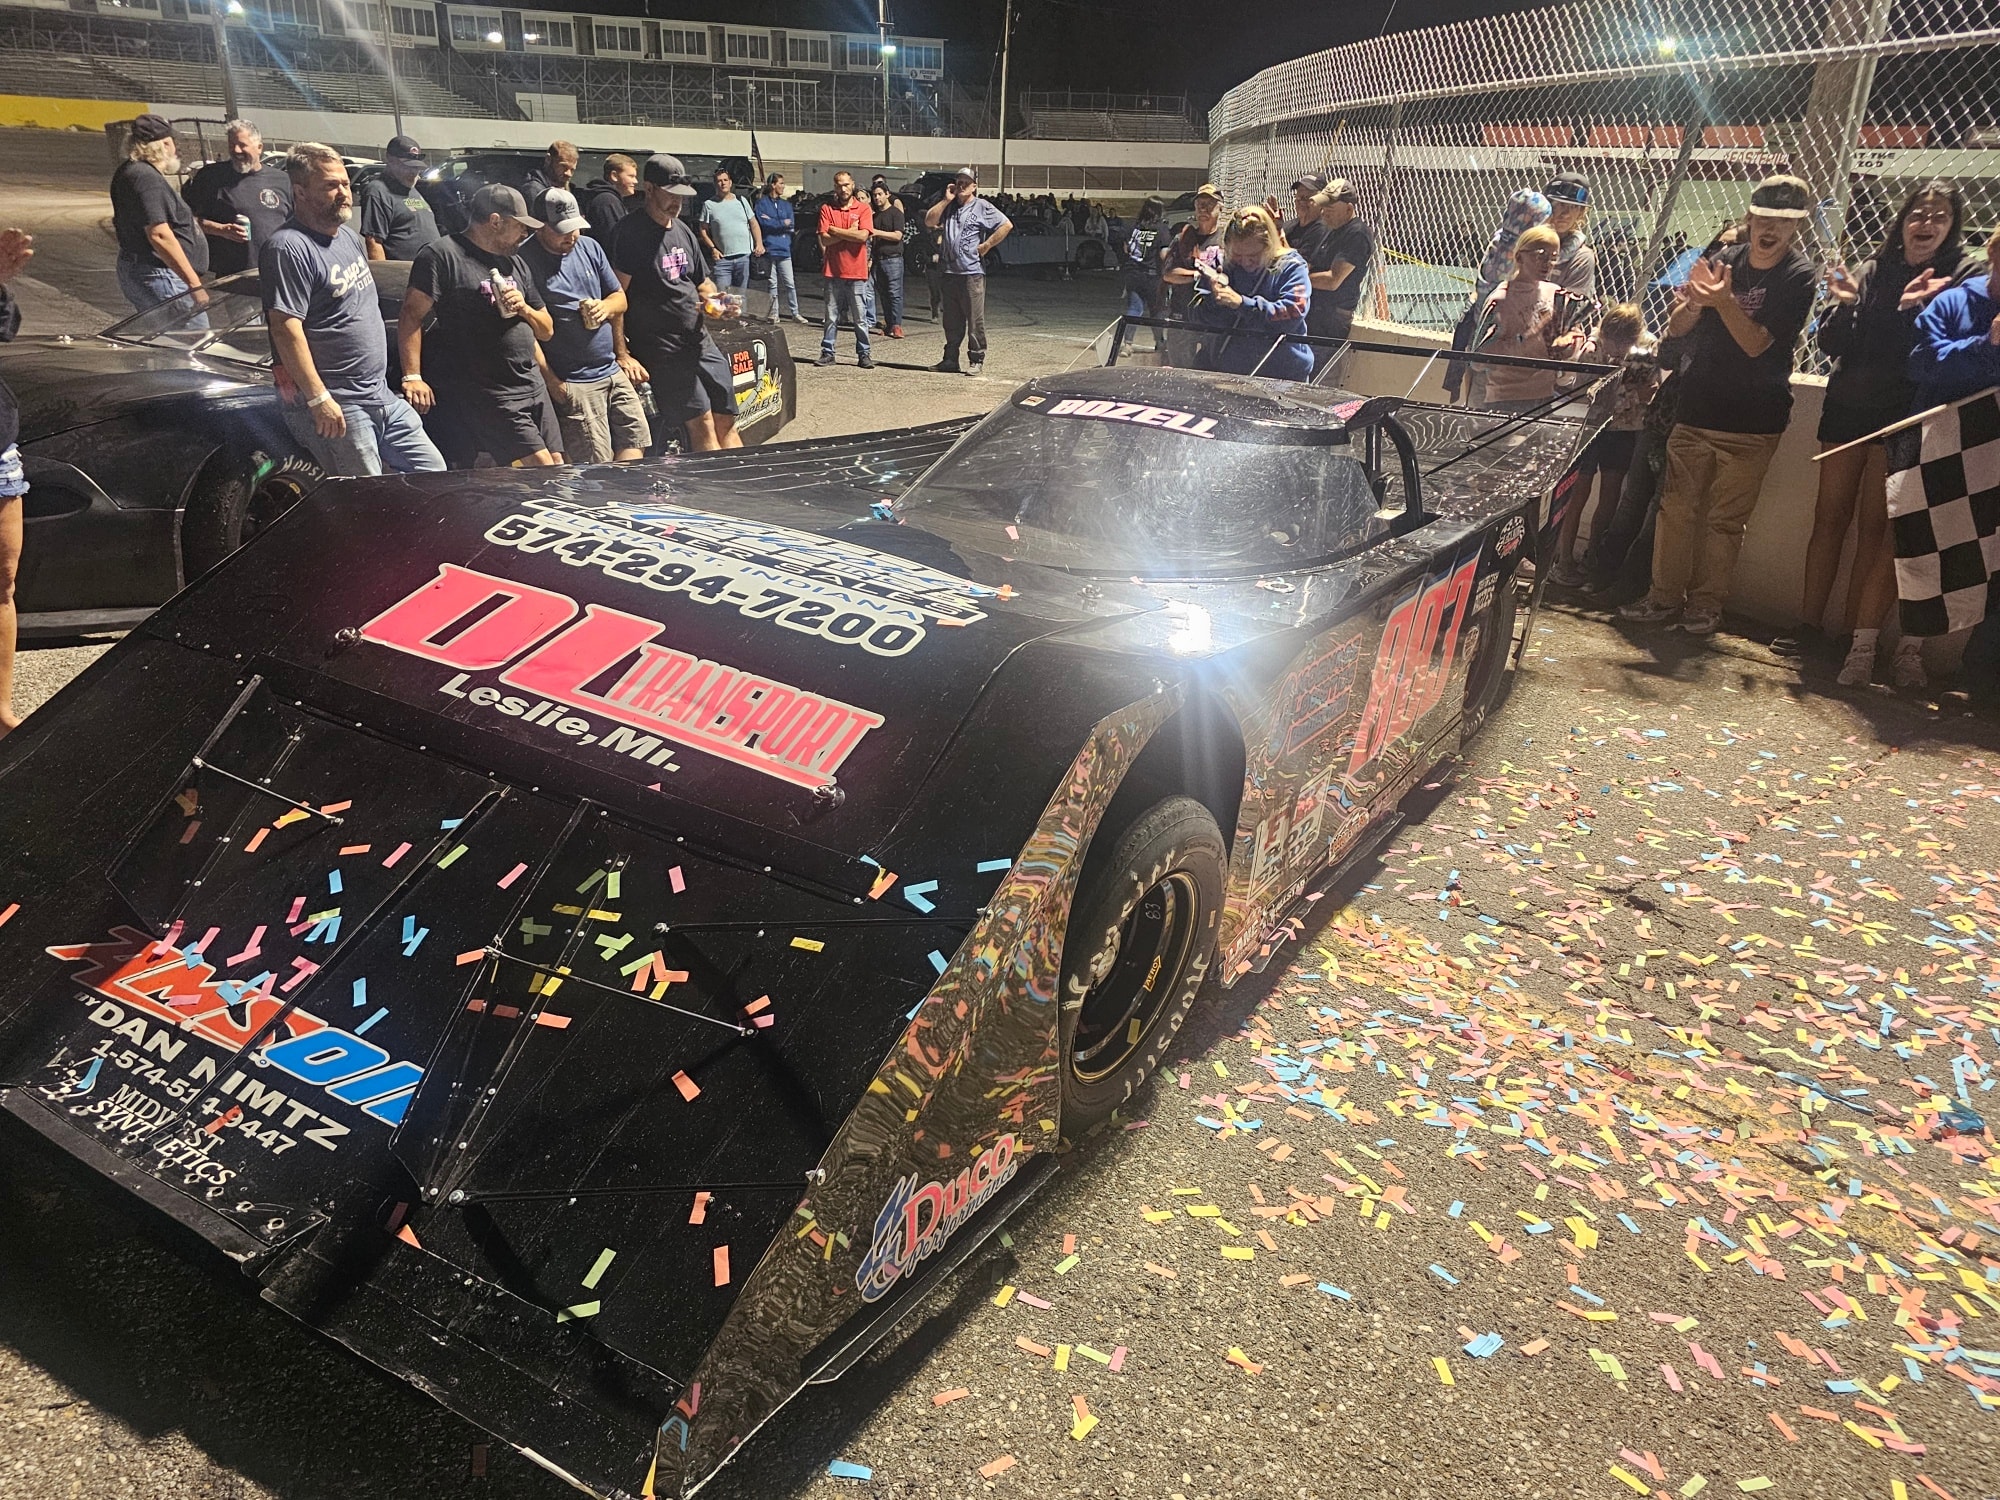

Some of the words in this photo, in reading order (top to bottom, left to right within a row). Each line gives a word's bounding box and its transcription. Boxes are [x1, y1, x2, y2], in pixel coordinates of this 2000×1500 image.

[732, 359, 754, 375] SALE
[733, 350, 750, 362] FOR
[1047, 399, 1219, 439] BOZELL
[491, 518, 920, 654] 574-294-7200
[552, 501, 754, 560] TRAILER
[774, 560, 964, 616] SALES
[738, 566, 920, 621] INDIANA
[361, 563, 667, 703] DL
[603, 643, 886, 780] TRANSPORT
[87, 1001, 188, 1064] DAN
[189, 1055, 350, 1152] NIMTZ
[901, 1133, 1015, 1262] Duco
